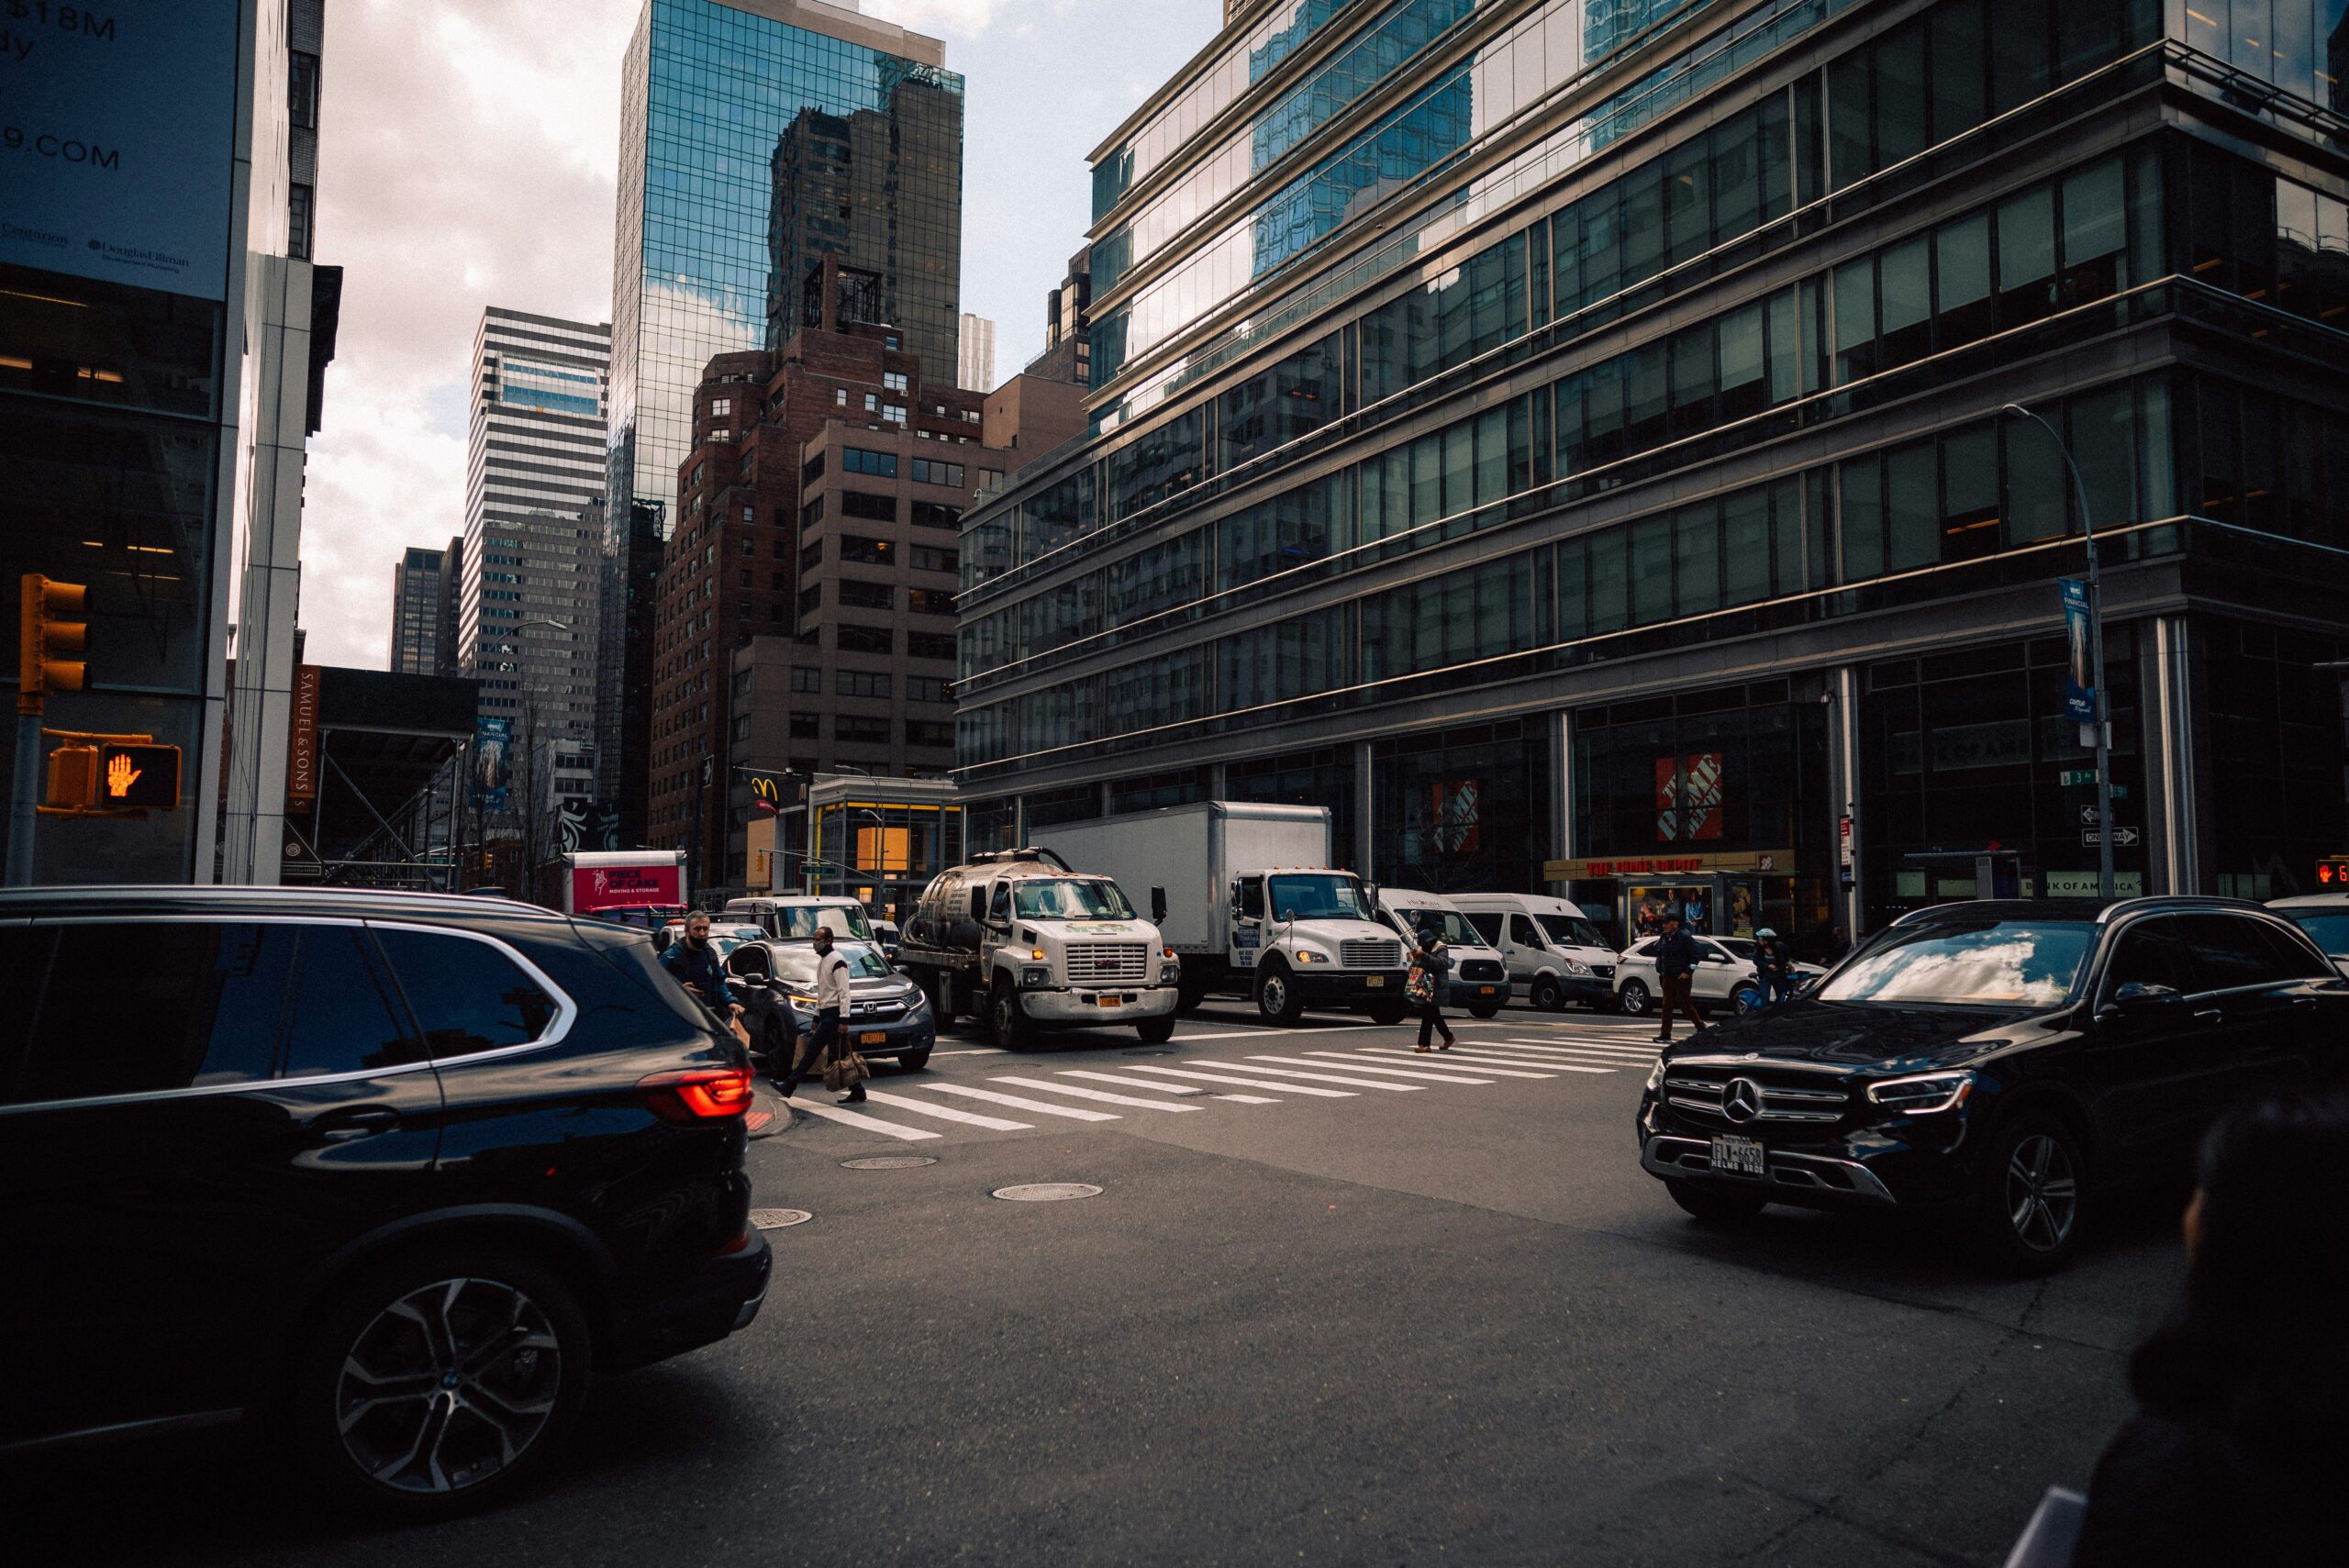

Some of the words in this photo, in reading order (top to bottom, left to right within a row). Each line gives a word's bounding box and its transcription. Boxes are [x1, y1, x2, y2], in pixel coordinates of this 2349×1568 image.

[299, 673, 314, 735] SAMUEL
[298, 737, 309, 747] &
[295, 749, 309, 791] SONS
[2076, 773, 2082, 784] 3
[2113, 833, 2131, 841] WAY
[609, 870, 640, 878] PIECE
[2339, 865, 2347, 882] 6
[609, 880, 624, 888] OF
[628, 878, 660, 887] CAKE
[2063, 882, 2078, 890] OF
[2081, 883, 2133, 891] AMICA
[1711, 1159, 1740, 1171] HELMS
